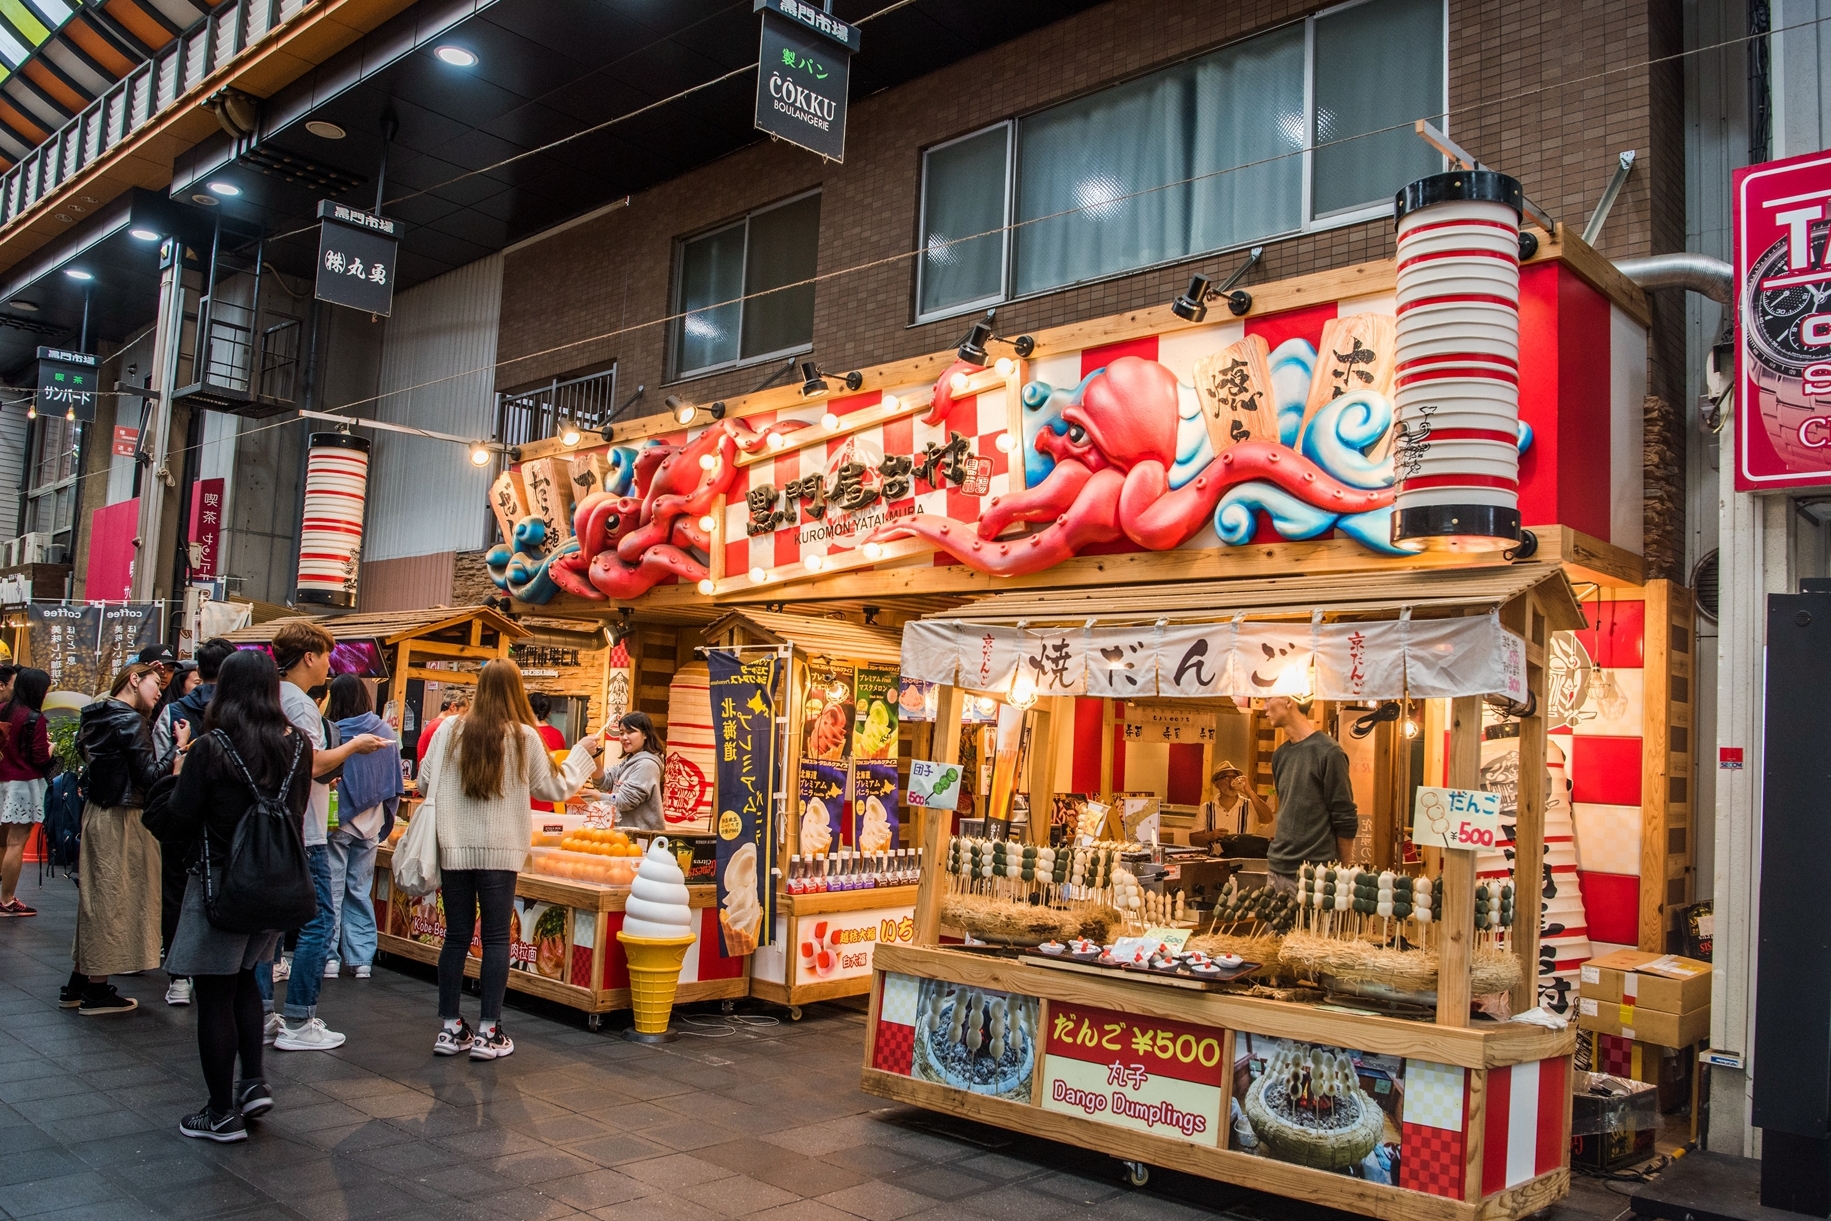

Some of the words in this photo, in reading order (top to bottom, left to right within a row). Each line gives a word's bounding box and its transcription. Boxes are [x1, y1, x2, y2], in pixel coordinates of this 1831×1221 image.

[782, 48, 829, 80] 製パン
[773, 99, 829, 132] BOULANGERIE
[334, 205, 394, 234] 黒門市場
[48, 349, 95, 365] 黒門市場
[54, 372, 83, 384] 喫茶
[44, 385, 90, 405] サンバード
[203, 493, 219, 525] 喫茶
[794, 522, 850, 546] KUROMON
[853, 502, 925, 532] YATAI-MURA
[981, 632, 996, 688] 京だんご
[1348, 631, 1366, 696] 京だんご
[859, 675, 881, 683] プレミアム
[859, 684, 888, 692] マスクメロン
[913, 762, 934, 777] 団子
[800, 779, 827, 789] プレミアム
[856, 780, 881, 788] プレミアム
[1449, 791, 1499, 815] だんご
[1450, 821, 1494, 847] ¥500
[413, 916, 433, 934] Kobe
[1163, 935, 1183, 944] 500
[1053, 1012, 1126, 1051] だんご
[1131, 1026, 1221, 1068] ¥500
[1107, 1059, 1149, 1090] 丸子
[1052, 1079, 1108, 1114] Dango
[1111, 1091, 1207, 1136] Dumplings
